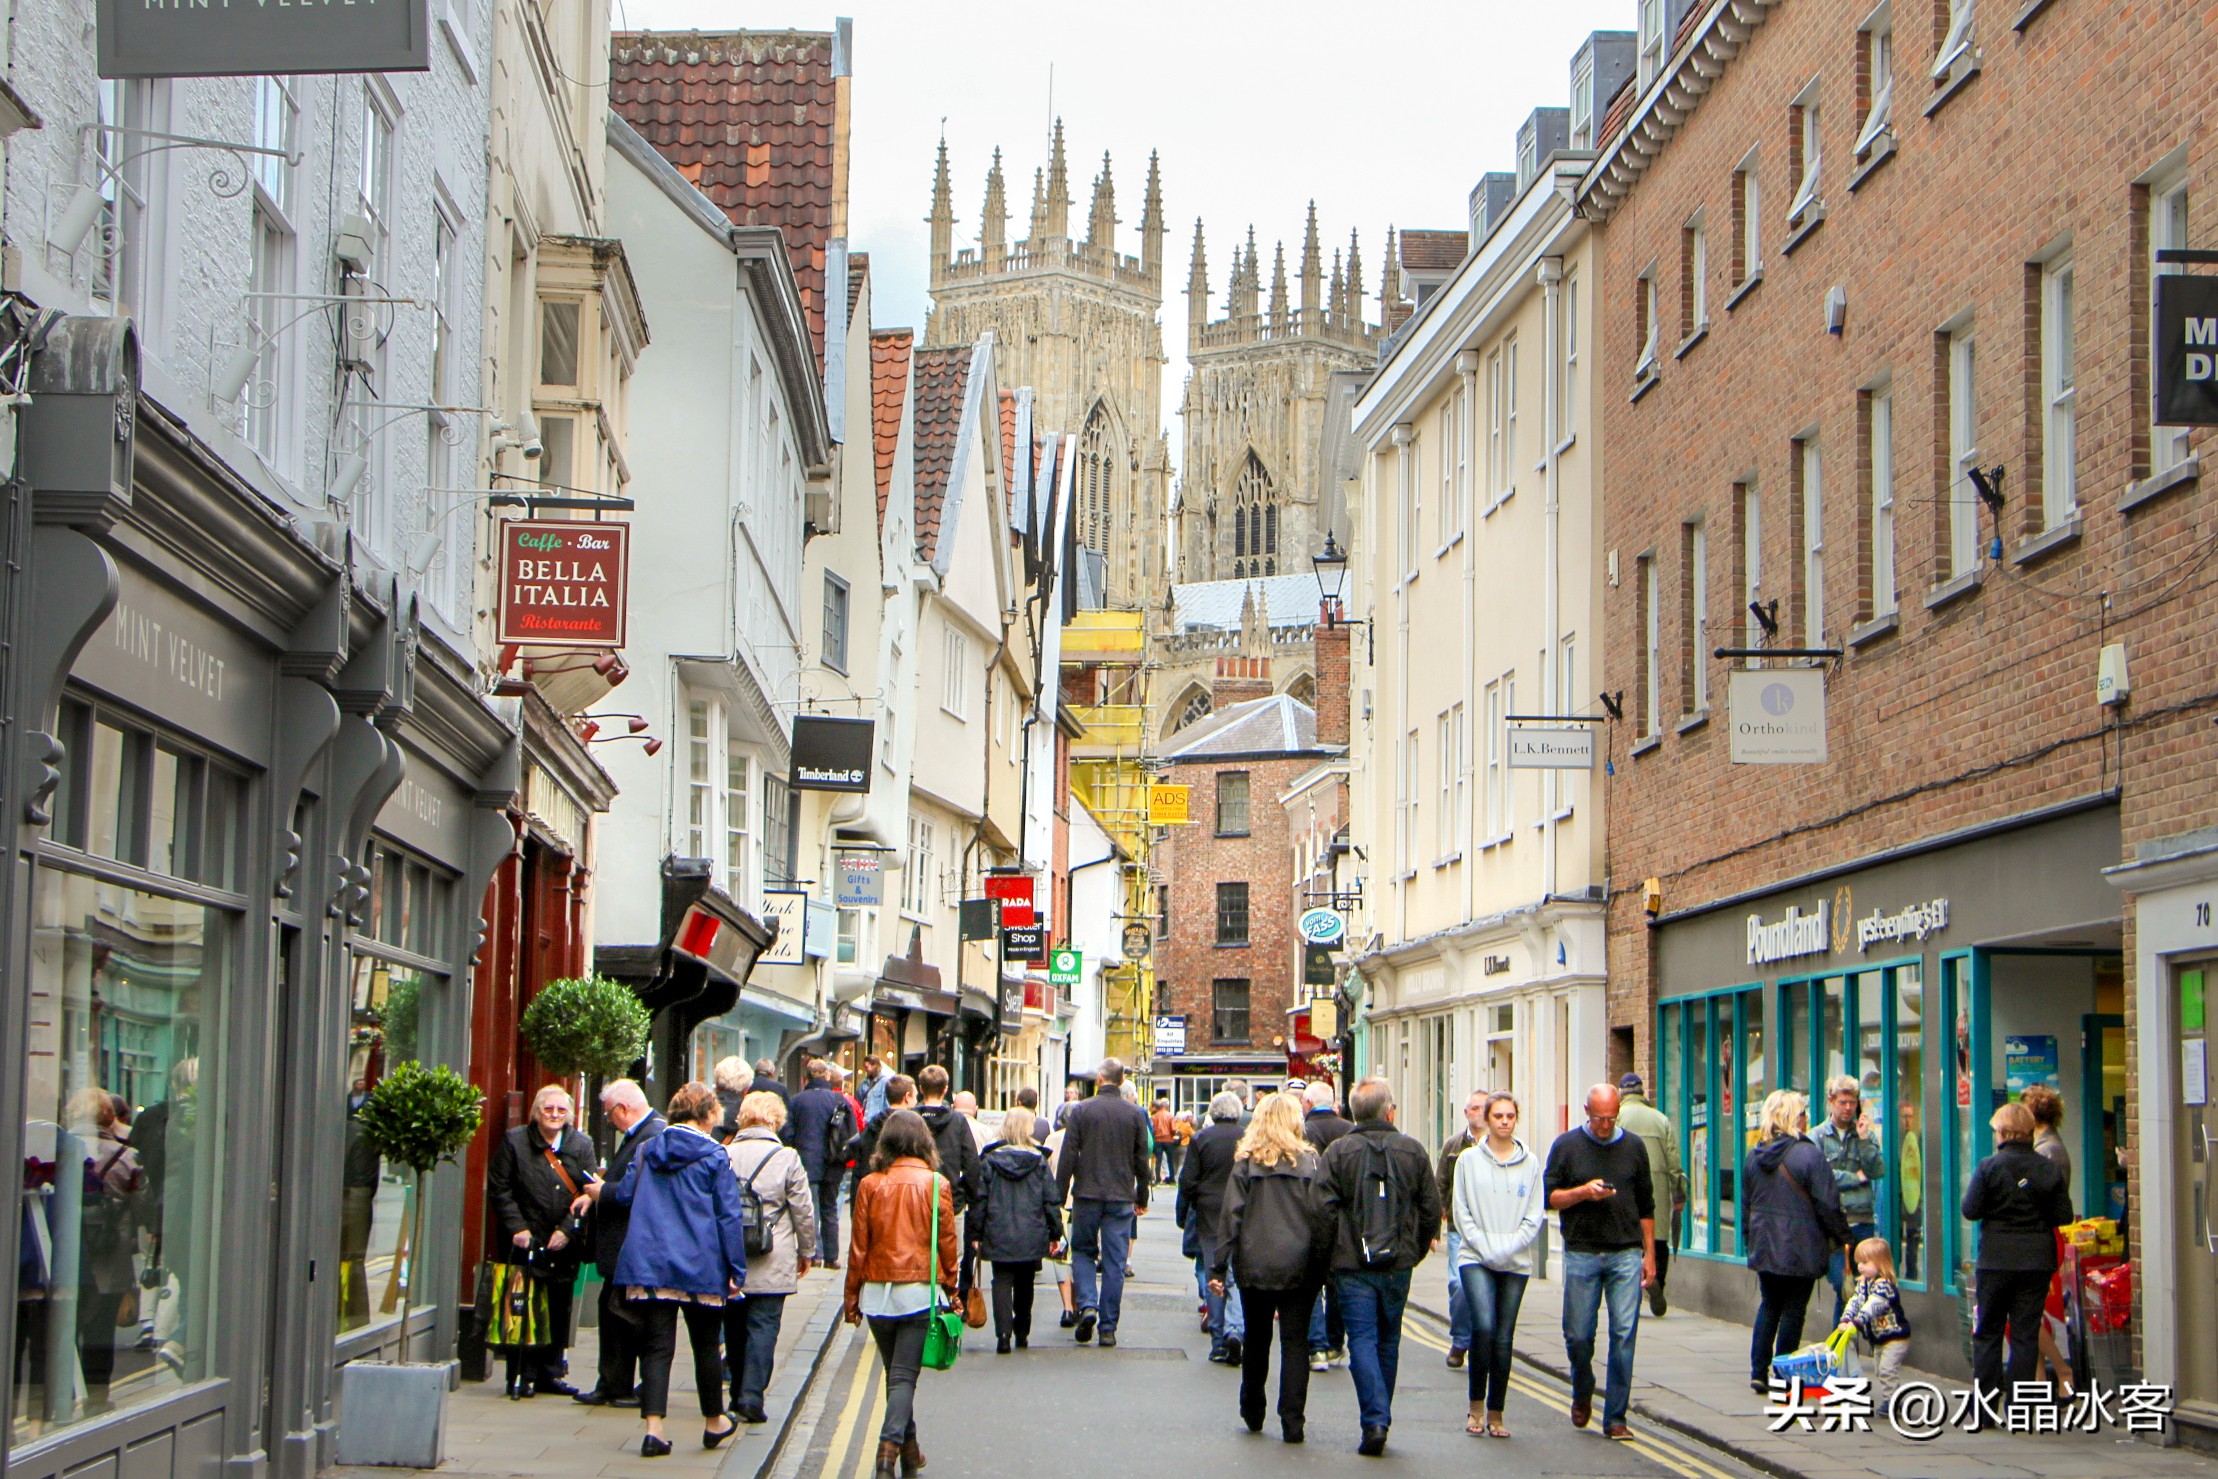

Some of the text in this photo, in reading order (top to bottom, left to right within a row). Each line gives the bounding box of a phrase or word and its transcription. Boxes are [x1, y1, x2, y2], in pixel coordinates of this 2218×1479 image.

[2186, 353, 2218, 381] D
[517, 532, 611, 552] Caffe Bar
[517, 559, 608, 583] BELLA
[513, 584, 610, 608] ITALIA
[520, 613, 602, 632] Ristorante
[115, 600, 225, 701] MINT VELVET
[1739, 721, 1818, 736] Orthokind
[797, 766, 850, 782] Timberland
[414, 784, 442, 830] VELVET
[1153, 792, 1186, 805] ADS
[847, 875, 871, 884] Gifts
[838, 894, 878, 905] Souvenirs
[855, 885, 862, 895] &
[2196, 902, 2210, 927] 70
[1304, 915, 1336, 938] FASS
[1747, 899, 1829, 965] Poundland
[1011, 933, 1036, 944] Shop
[1052, 974, 1079, 982] OXFAM
